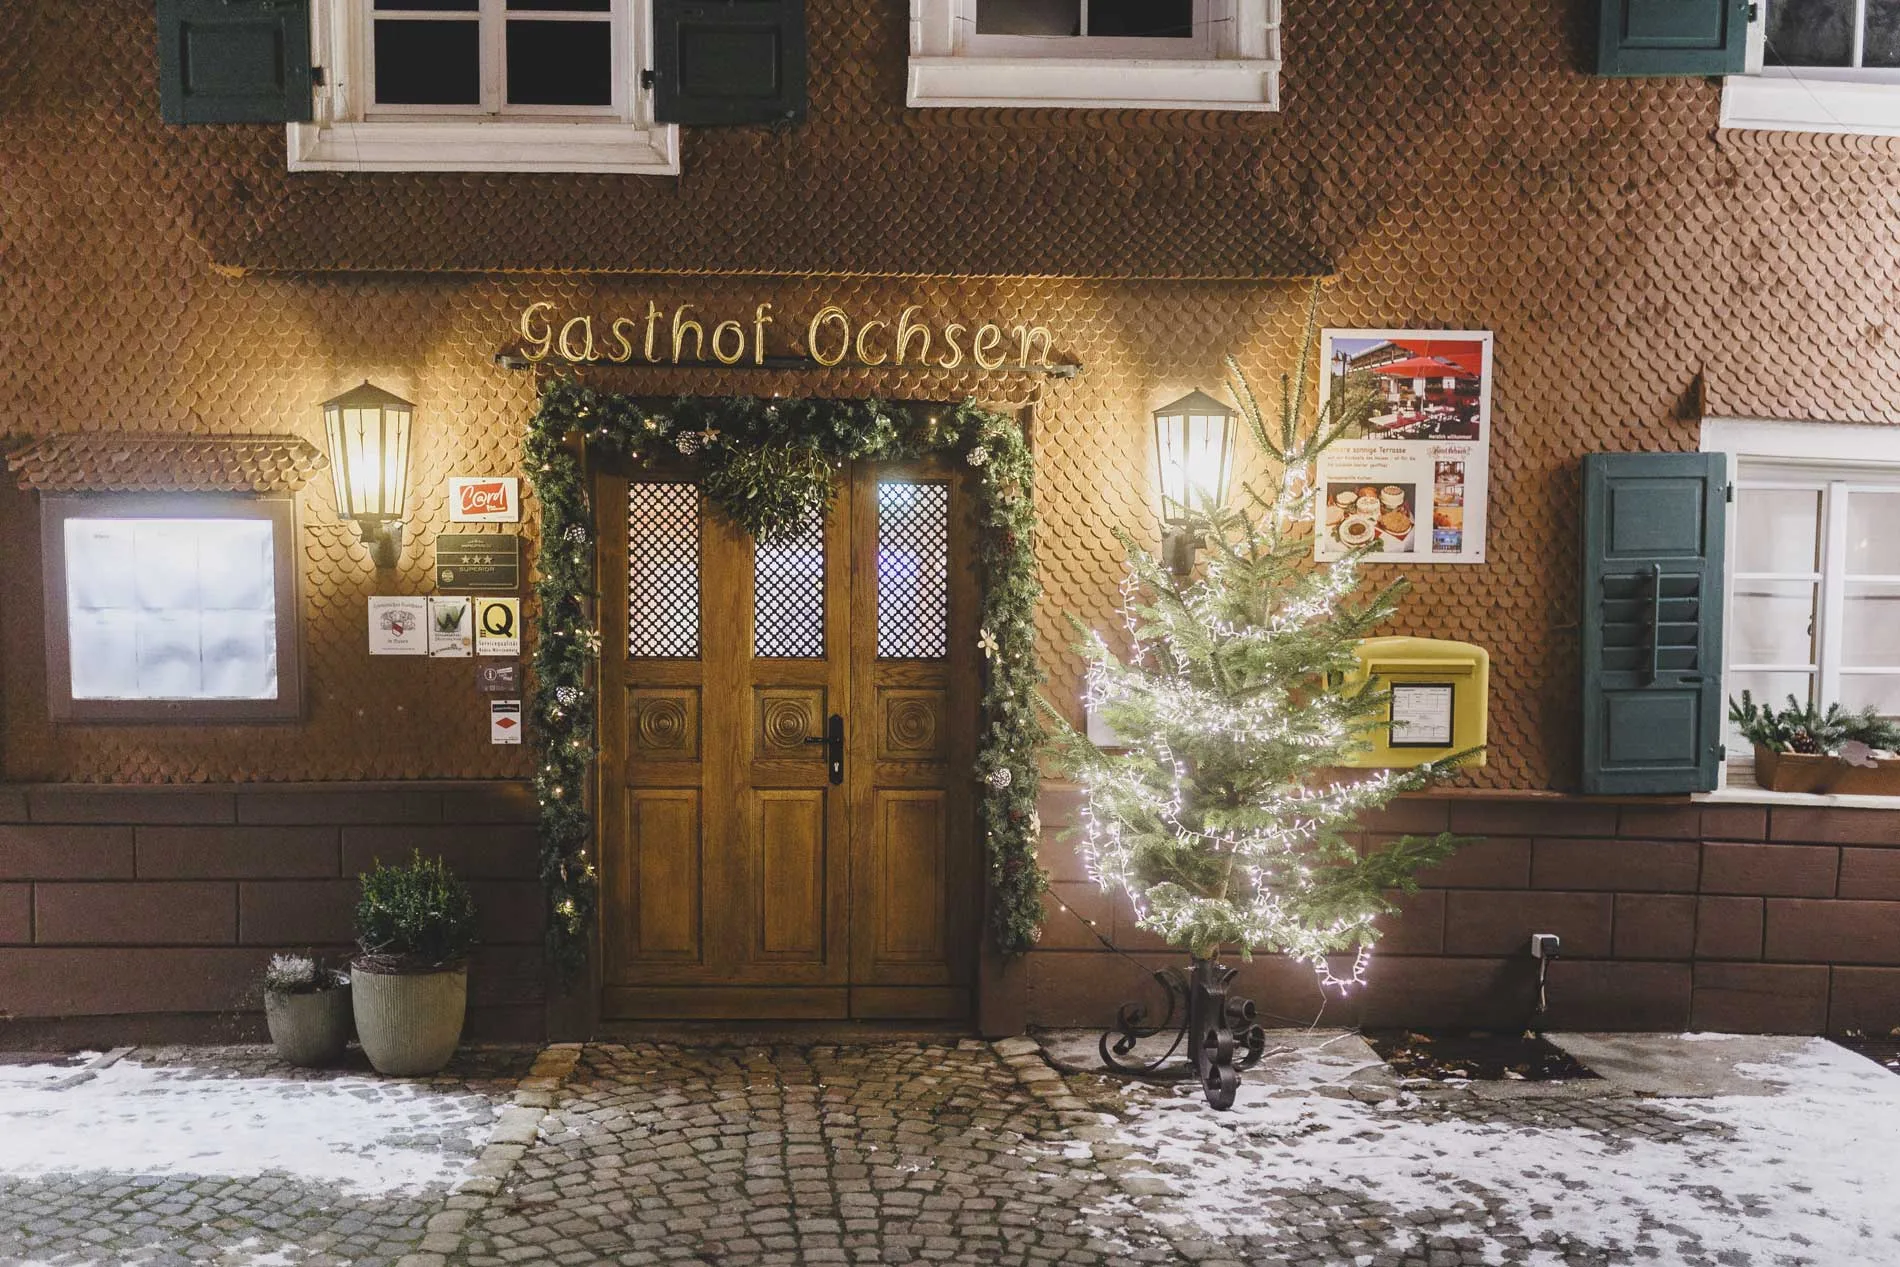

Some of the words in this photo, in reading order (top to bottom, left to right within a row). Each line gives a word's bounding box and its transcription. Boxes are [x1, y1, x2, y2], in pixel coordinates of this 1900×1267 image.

[520, 300, 772, 364] Gasthof
[808, 305, 1054, 370] Ochsen
[1379, 446, 1407, 454] Terrasse
[461, 483, 506, 511] C@rd
[482, 602, 514, 638] Q
